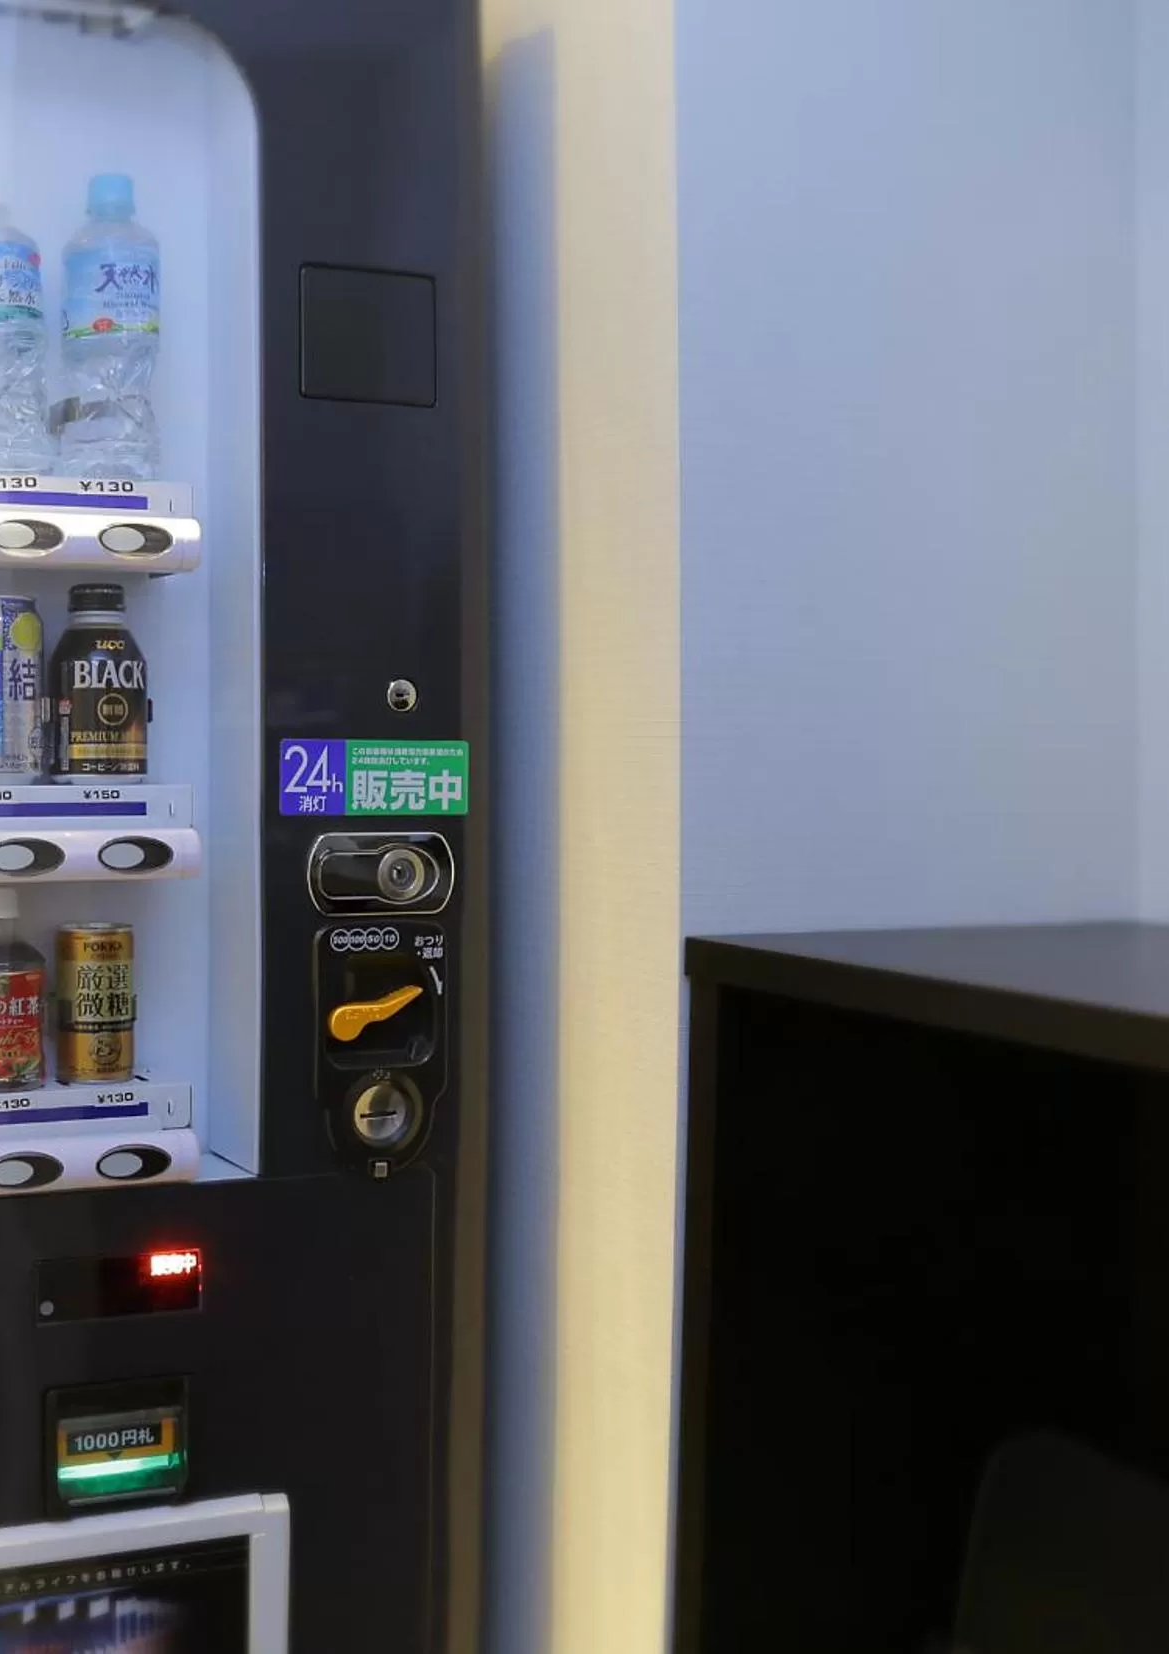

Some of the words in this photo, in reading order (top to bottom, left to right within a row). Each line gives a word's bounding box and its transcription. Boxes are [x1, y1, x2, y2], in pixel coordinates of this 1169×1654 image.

[79, 480, 134, 493] ¥130
[73, 660, 145, 689] BLACK
[352, 769, 462, 811] 販売中
[298, 796, 327, 812] 消灯
[414, 935, 444, 947] おつり
[76, 964, 129, 991] 厳選
[76, 992, 129, 1018] 微糖
[97, 1092, 134, 1104] ¥130
[74, 1428, 154, 1451] 1000円札
